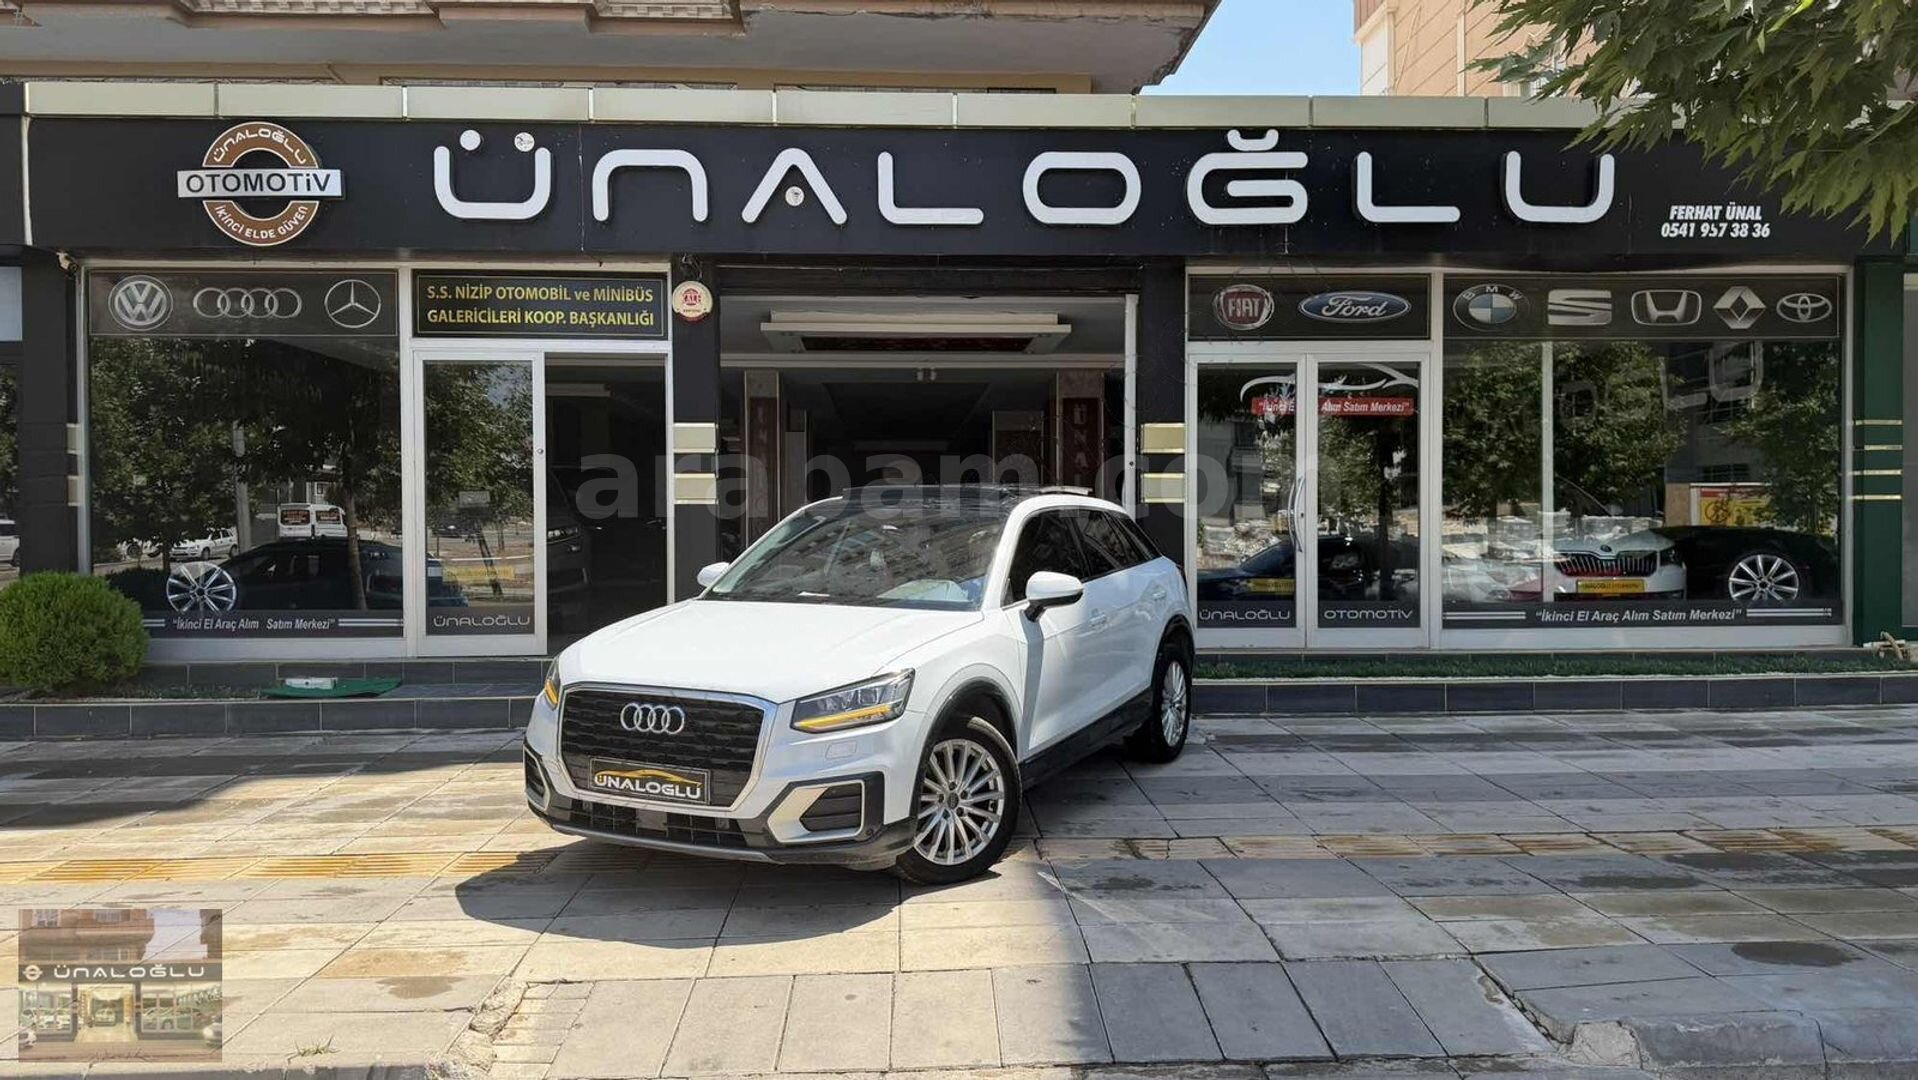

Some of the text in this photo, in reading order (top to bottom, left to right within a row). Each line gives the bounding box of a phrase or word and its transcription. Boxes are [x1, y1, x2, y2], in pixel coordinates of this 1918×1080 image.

[433, 129, 1615, 227] ÜNALOĞLU
[1669, 201, 1762, 220] FERHAT ÜNAL
[244, 228, 276, 240] ELDE
[1660, 222, 1696, 238] 0541
[1729, 222, 1749, 238] 38
[1752, 222, 1771, 238] 36
[427, 283, 653, 303] S.S. NİZİP OTOMOBİL ve MİNİBÜS
[1227, 298, 1260, 317] FIAT
[1321, 295, 1388, 318] Ford
[427, 308, 654, 329] GALERİCİLERİ KOOP. BAŞKANLIĞI
[433, 614, 530, 627] ÜNALOĞLU
[1199, 608, 1290, 620] ÜNALOĞLU
[1577, 610, 1589, 621] El
[1591, 610, 1618, 623] Araç
[1624, 609, 1649, 621] Alım
[1652, 609, 1686, 621] Satım
[204, 618, 213, 630] El
[215, 618, 236, 632] Araç
[238, 618, 259, 630] Alım
[266, 618, 293, 630] Satım
